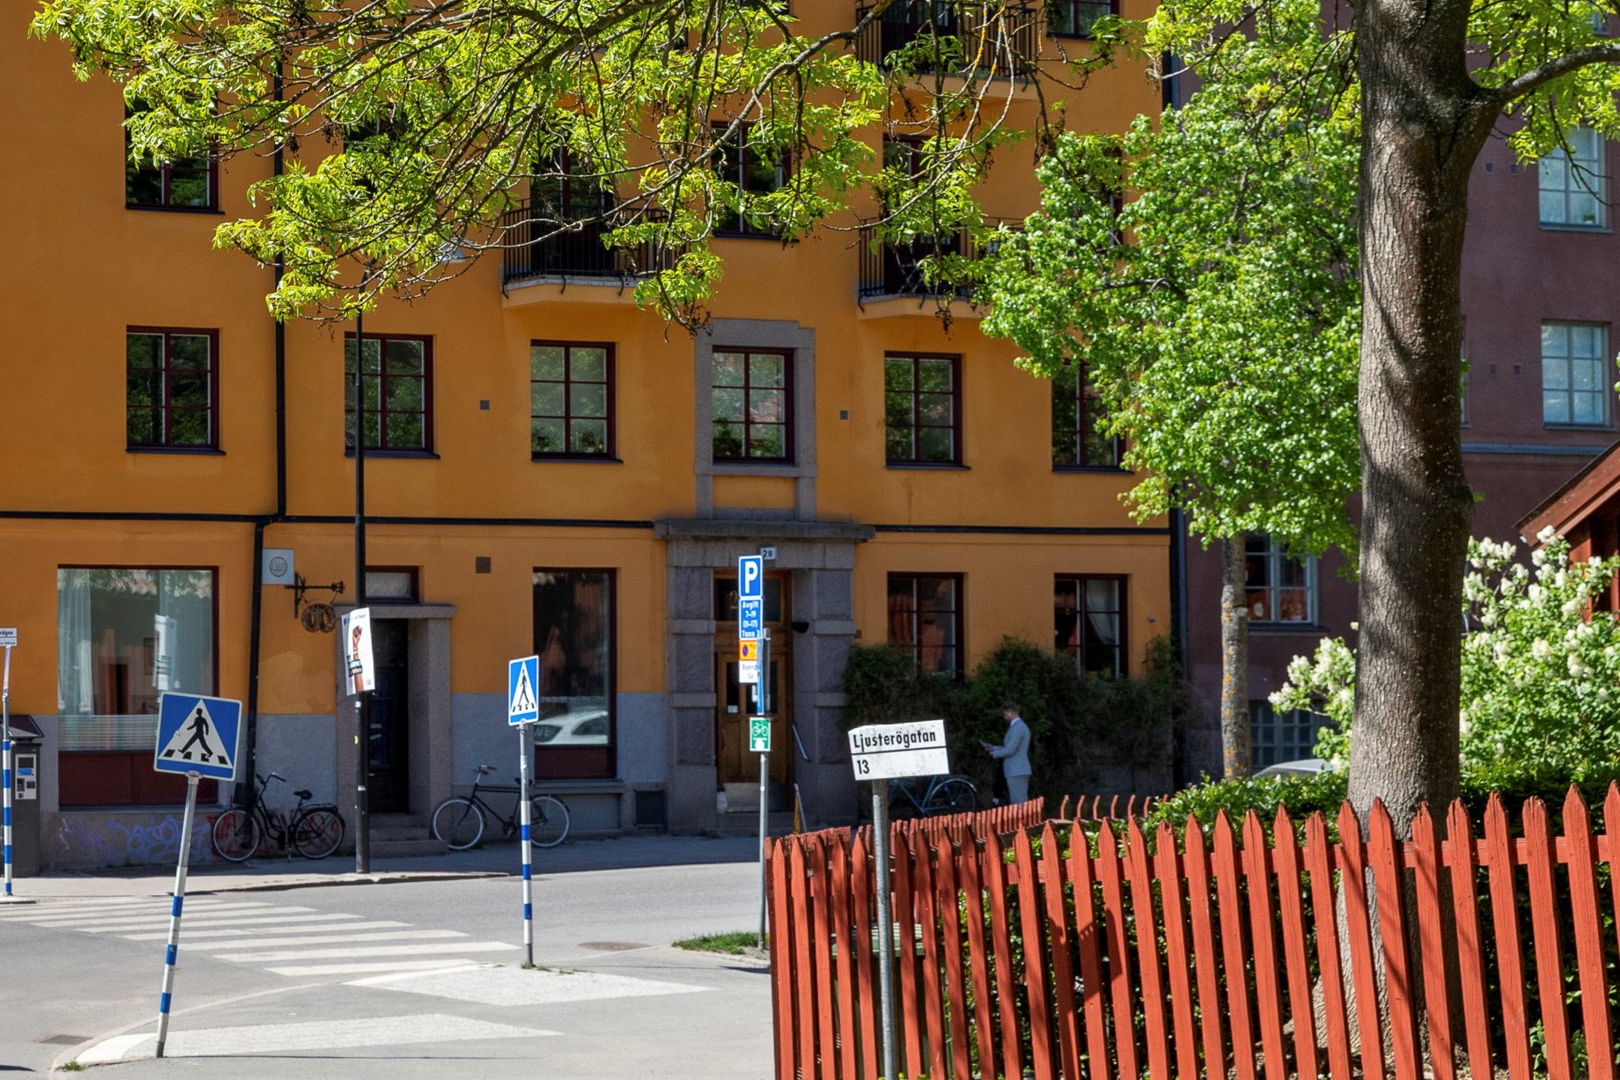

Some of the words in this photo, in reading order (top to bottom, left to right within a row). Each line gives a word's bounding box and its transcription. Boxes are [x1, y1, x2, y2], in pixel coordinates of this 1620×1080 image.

[762, 549, 773, 558] 28
[744, 560, 759, 594] P
[742, 601, 759, 610] Avgift
[853, 730, 936, 752] Ljusterögatan
[856, 759, 870, 775] 13
